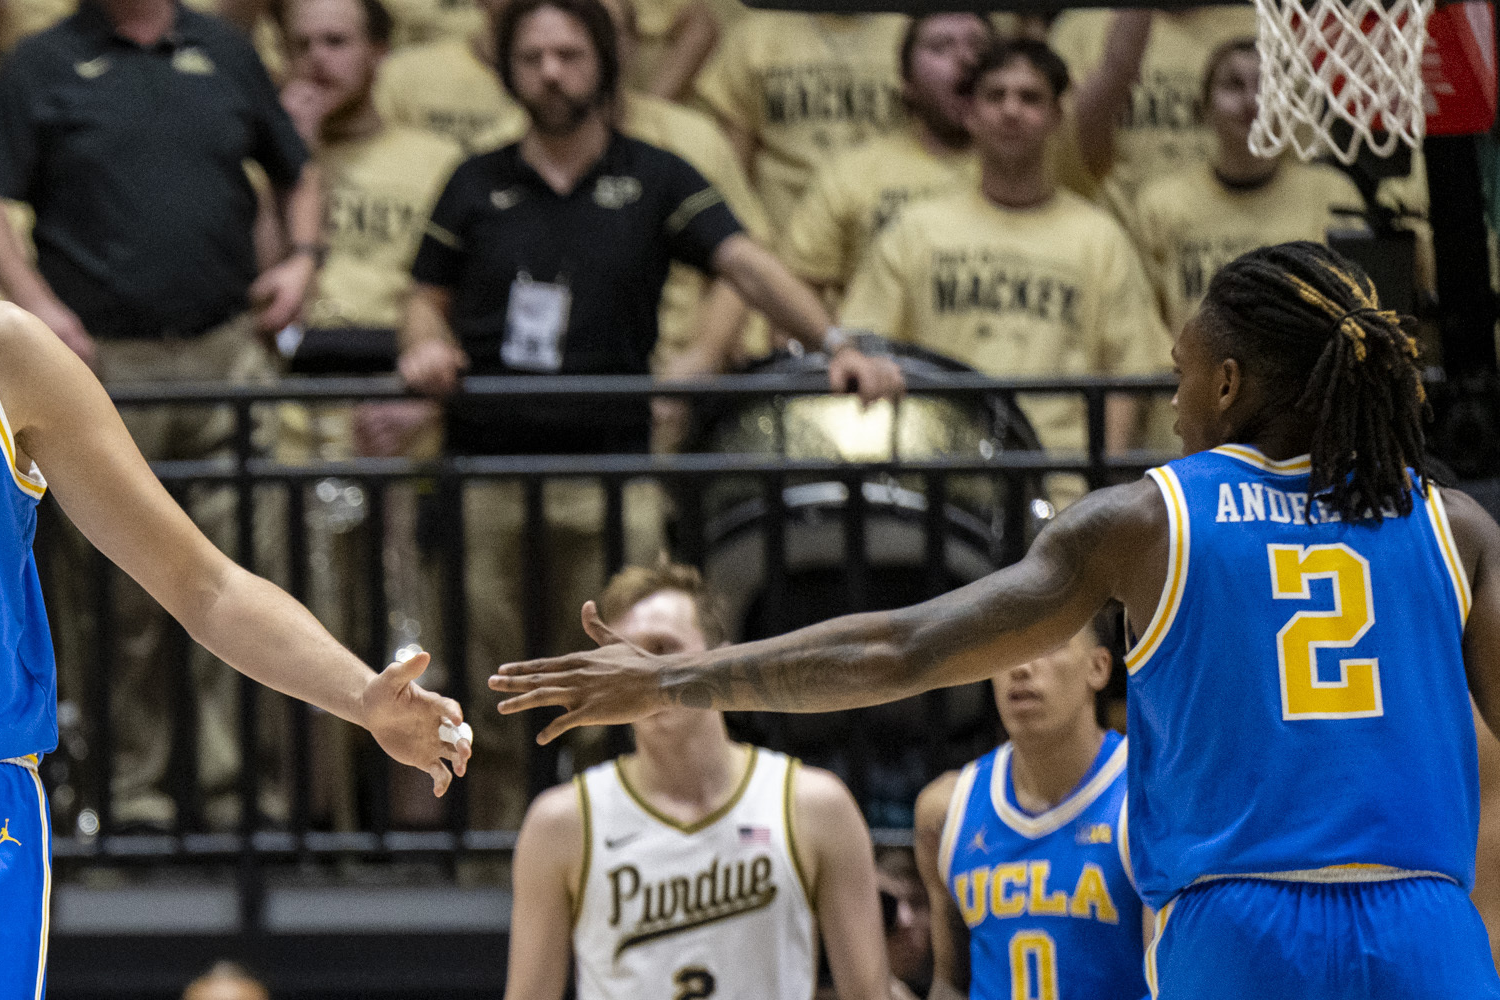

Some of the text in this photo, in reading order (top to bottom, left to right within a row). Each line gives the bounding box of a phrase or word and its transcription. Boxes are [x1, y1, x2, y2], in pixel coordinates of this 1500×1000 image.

[1266, 542, 1384, 721] 2
[607, 853, 779, 940] Purdue
[953, 857, 1120, 930] UCLA
